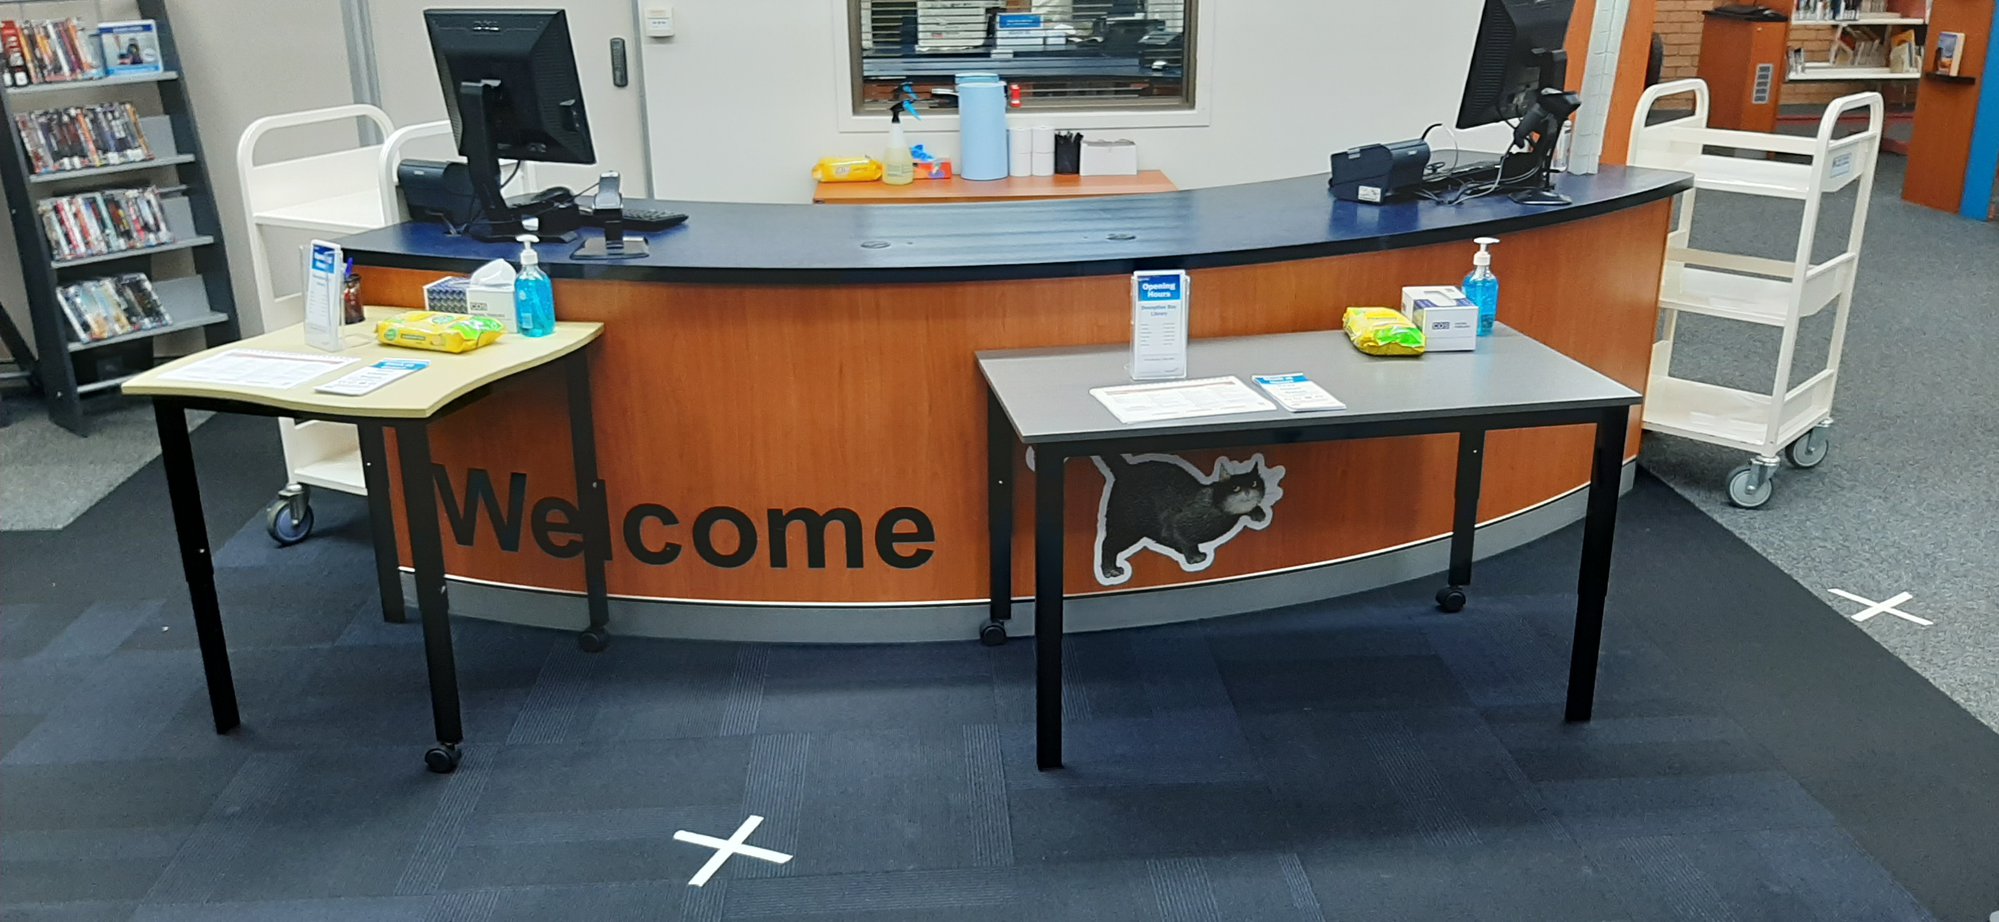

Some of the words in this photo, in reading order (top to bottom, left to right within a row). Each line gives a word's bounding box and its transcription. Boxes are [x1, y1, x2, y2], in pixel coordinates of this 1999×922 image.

[1142, 282, 1176, 291] Opening
[1147, 290, 1172, 298] Hours
[431, 463, 936, 570] Welcome
